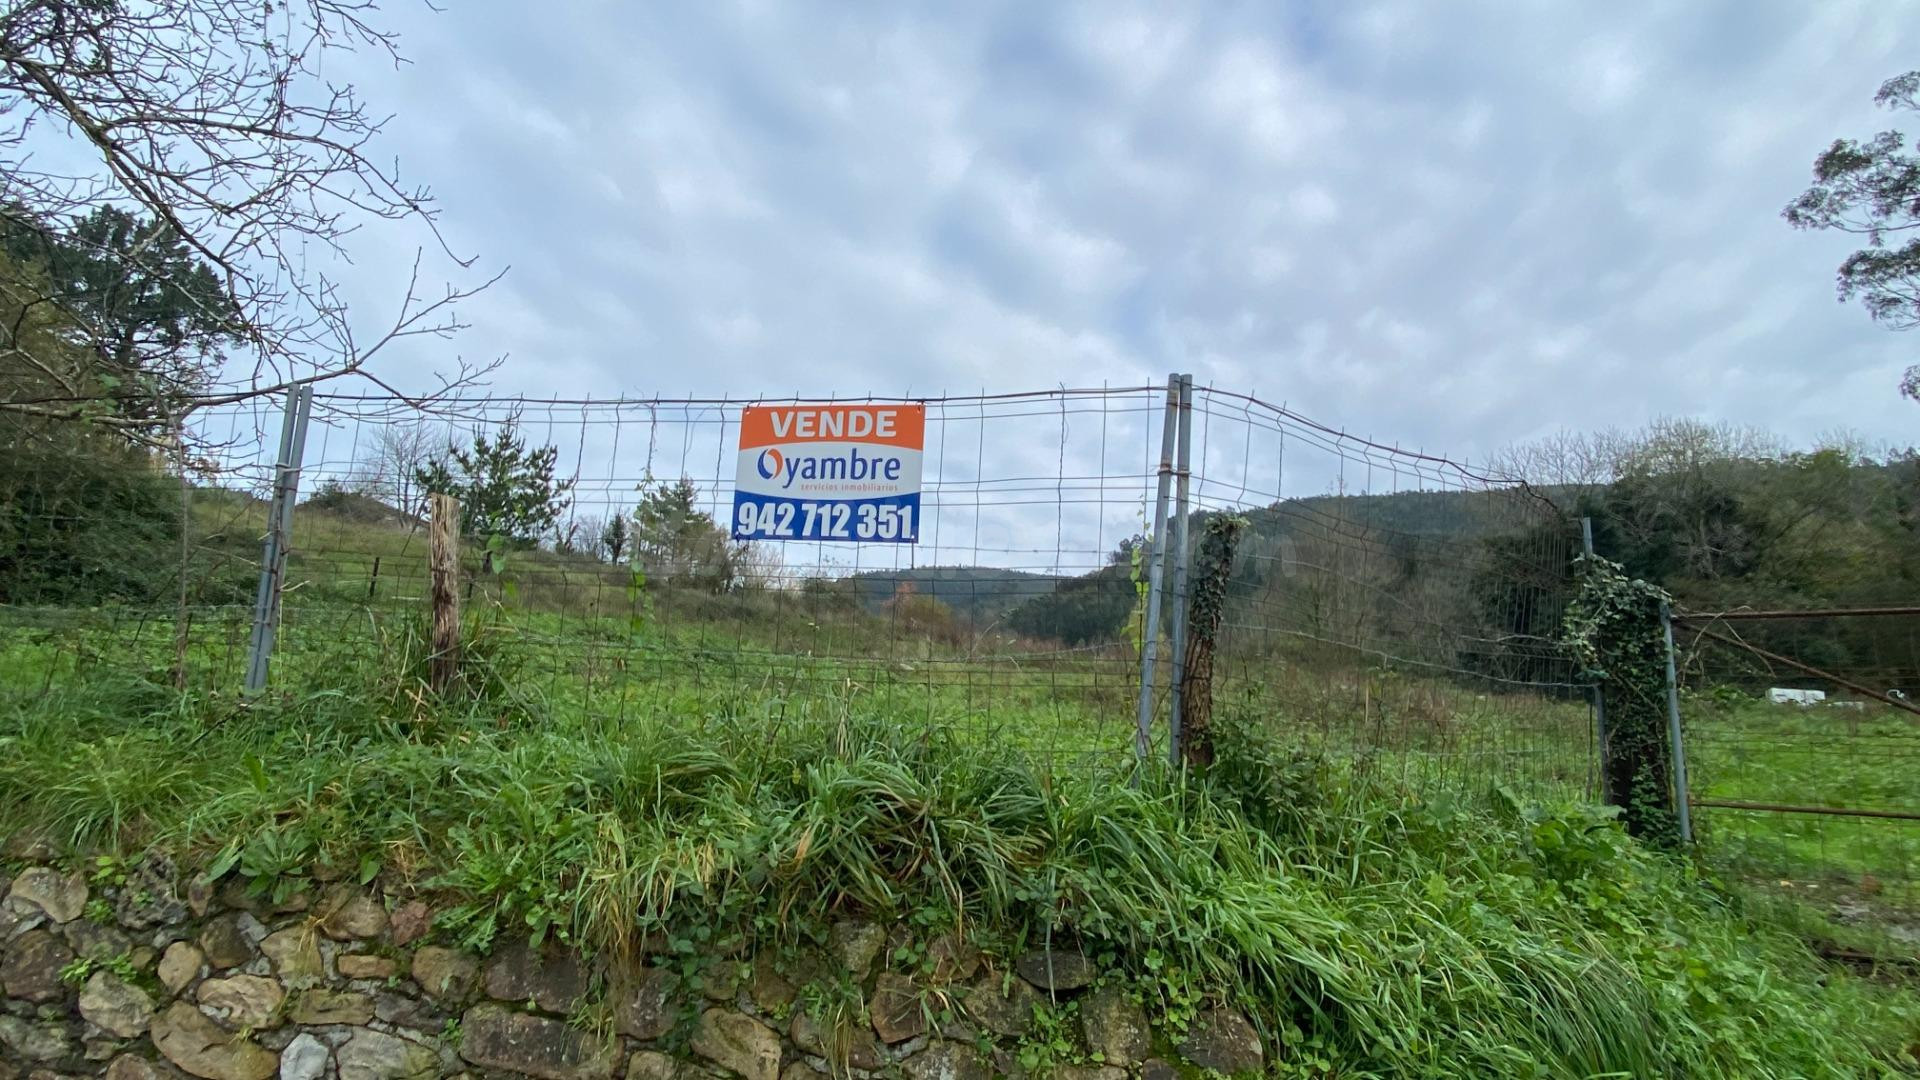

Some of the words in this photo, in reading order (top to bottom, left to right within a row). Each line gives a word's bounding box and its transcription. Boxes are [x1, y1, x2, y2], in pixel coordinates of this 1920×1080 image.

[770, 410, 897, 438] VENDE
[757, 447, 901, 489] Oyambre
[800, 483, 838, 491] servicios
[841, 482, 898, 491] inmobiliarios
[737, 501, 796, 537] 942
[802, 503, 852, 537] 712
[857, 504, 912, 539] 351
